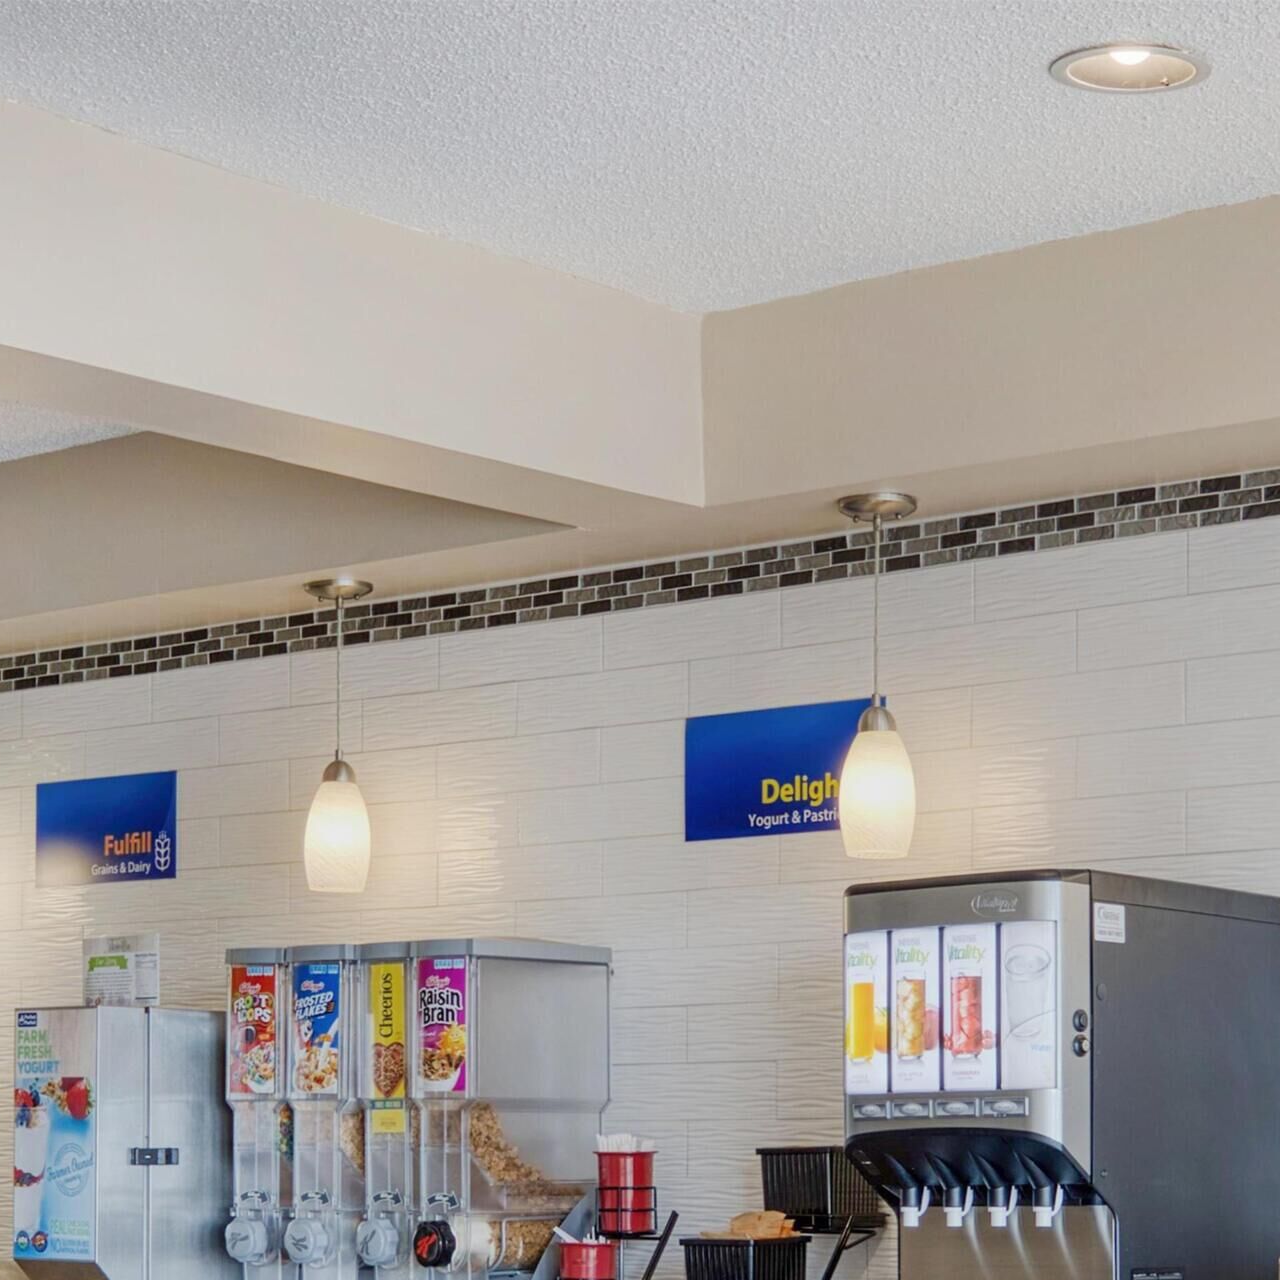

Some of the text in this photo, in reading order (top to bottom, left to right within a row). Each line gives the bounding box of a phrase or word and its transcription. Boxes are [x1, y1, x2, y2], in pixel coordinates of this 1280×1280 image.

[761, 772, 839, 807] Deligh
[748, 807, 839, 829] Yogurt & Pastri
[103, 831, 152, 857] Fulfill
[91, 861, 151, 875] Grains & Dairy
[295, 991, 334, 1011] FROSTED
[379, 973, 393, 1038] Cheerios
[419, 989, 461, 1009] Raisin
[237, 1007, 272, 1023] LOOPS
[295, 1003, 328, 1020] FLAKES
[423, 1006, 455, 1025] Bran
[17, 1029, 49, 1044] FARM
[17, 1046, 52, 1059] FRESH
[17, 1060, 59, 1073] YOGURT
